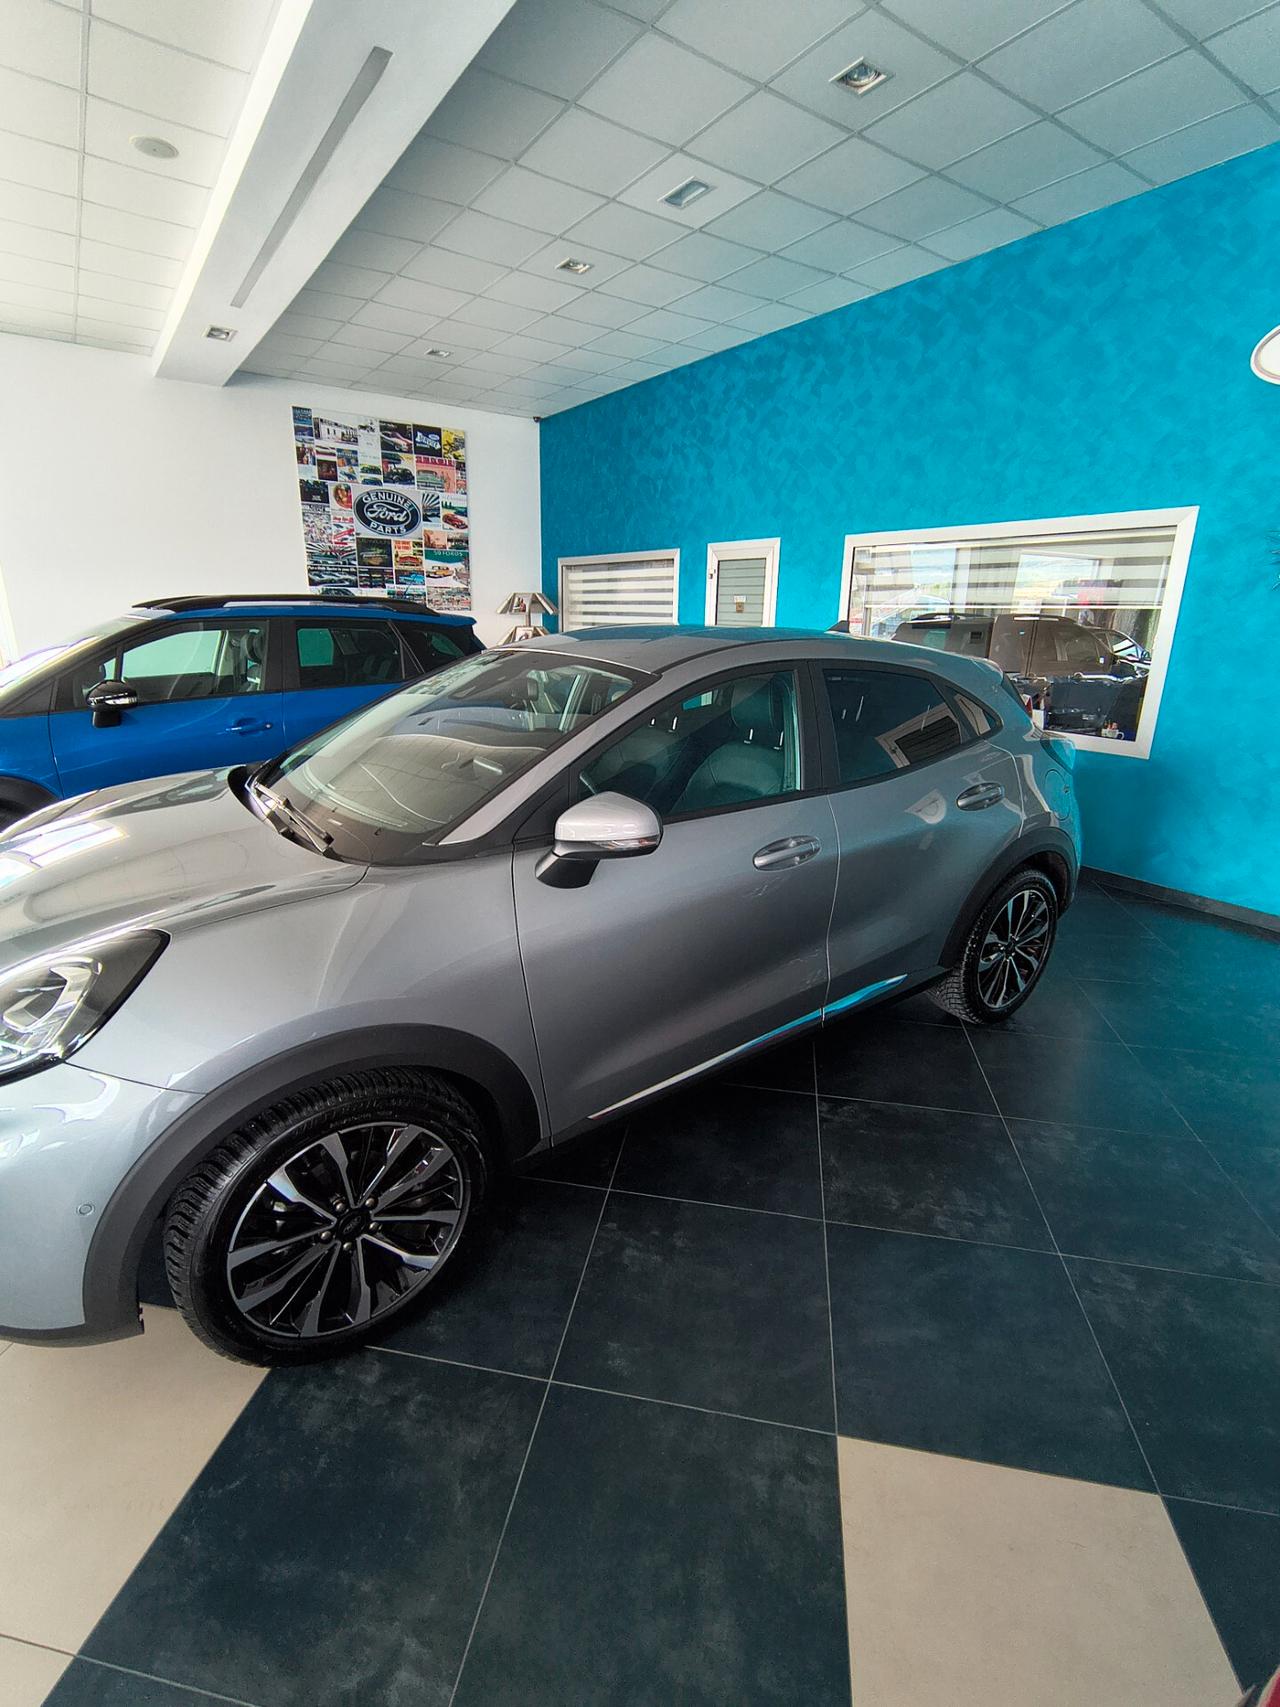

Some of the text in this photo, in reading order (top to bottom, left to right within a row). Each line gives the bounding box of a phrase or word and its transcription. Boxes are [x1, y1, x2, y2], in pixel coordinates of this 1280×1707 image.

[362, 491, 413, 509] GENUINE
[367, 502, 408, 522] Ford
[370, 521, 407, 535] PARTS
